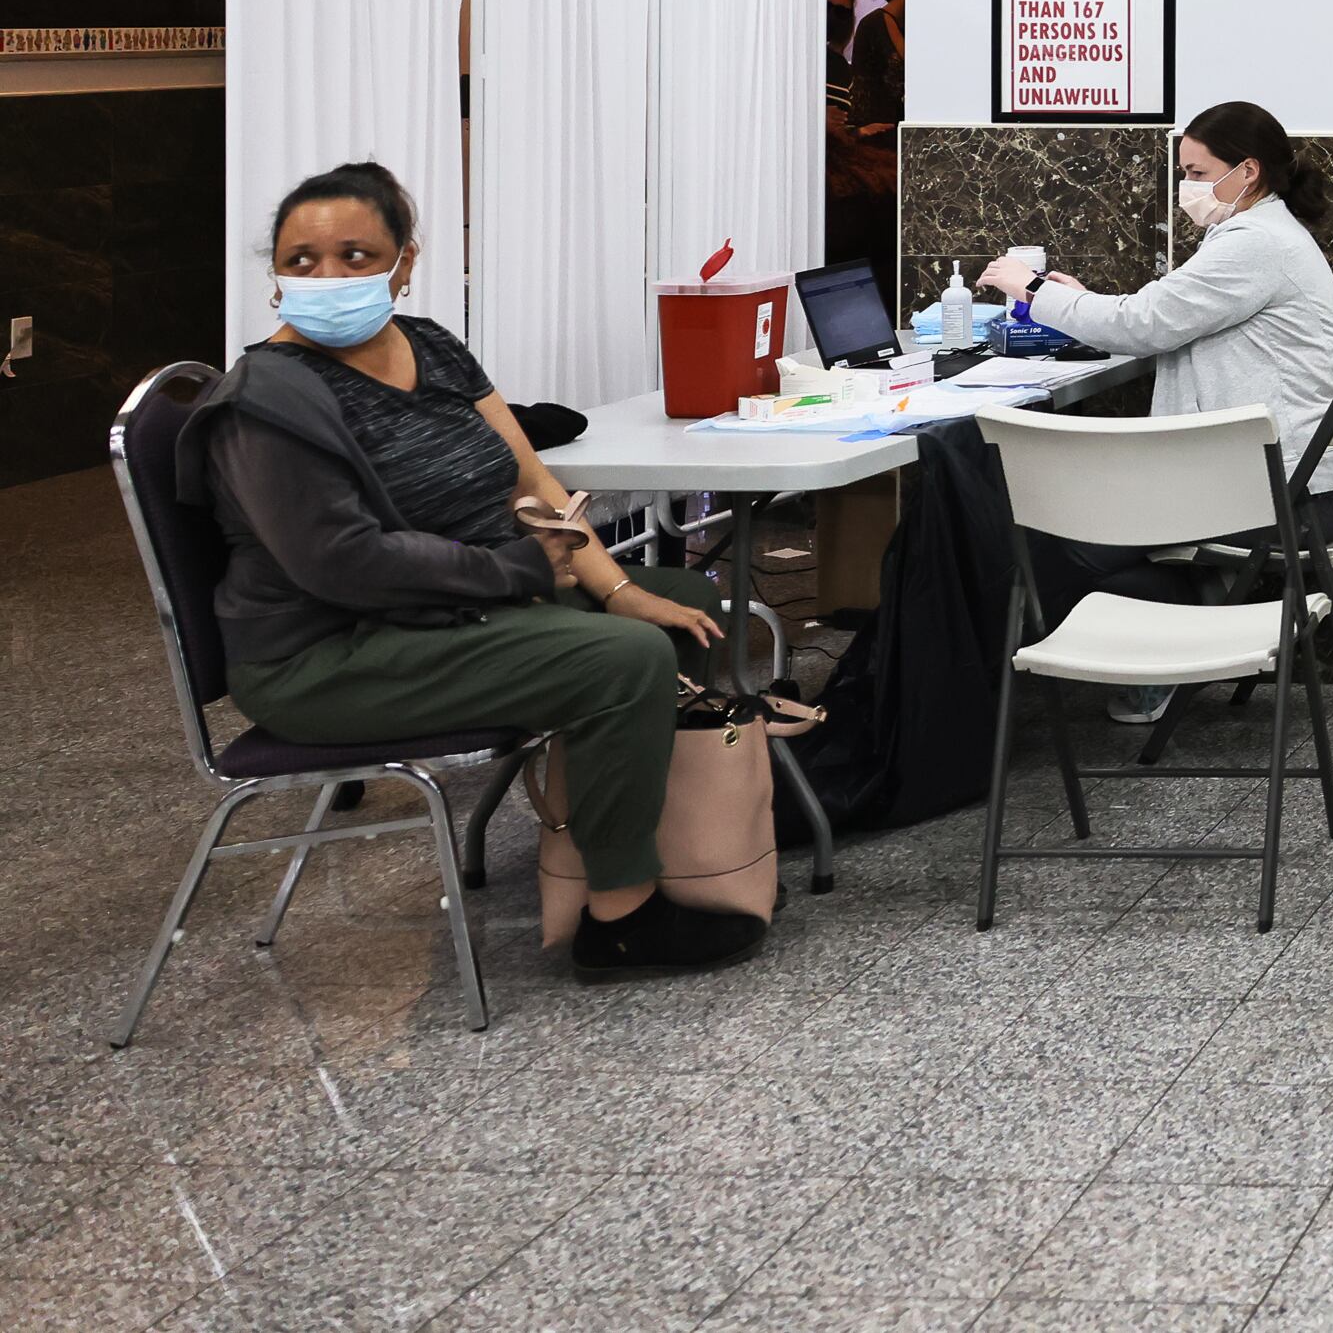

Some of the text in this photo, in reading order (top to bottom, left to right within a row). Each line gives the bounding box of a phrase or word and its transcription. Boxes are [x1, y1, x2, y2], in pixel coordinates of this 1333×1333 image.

[1018, 1, 1105, 18] THAN 167
[1018, 22, 1118, 40] PERSONS IS
[1018, 44, 1123, 62] DANGEROUS
[1018, 66, 1057, 83] AND
[1018, 88, 1119, 106] UNLAWFULL
